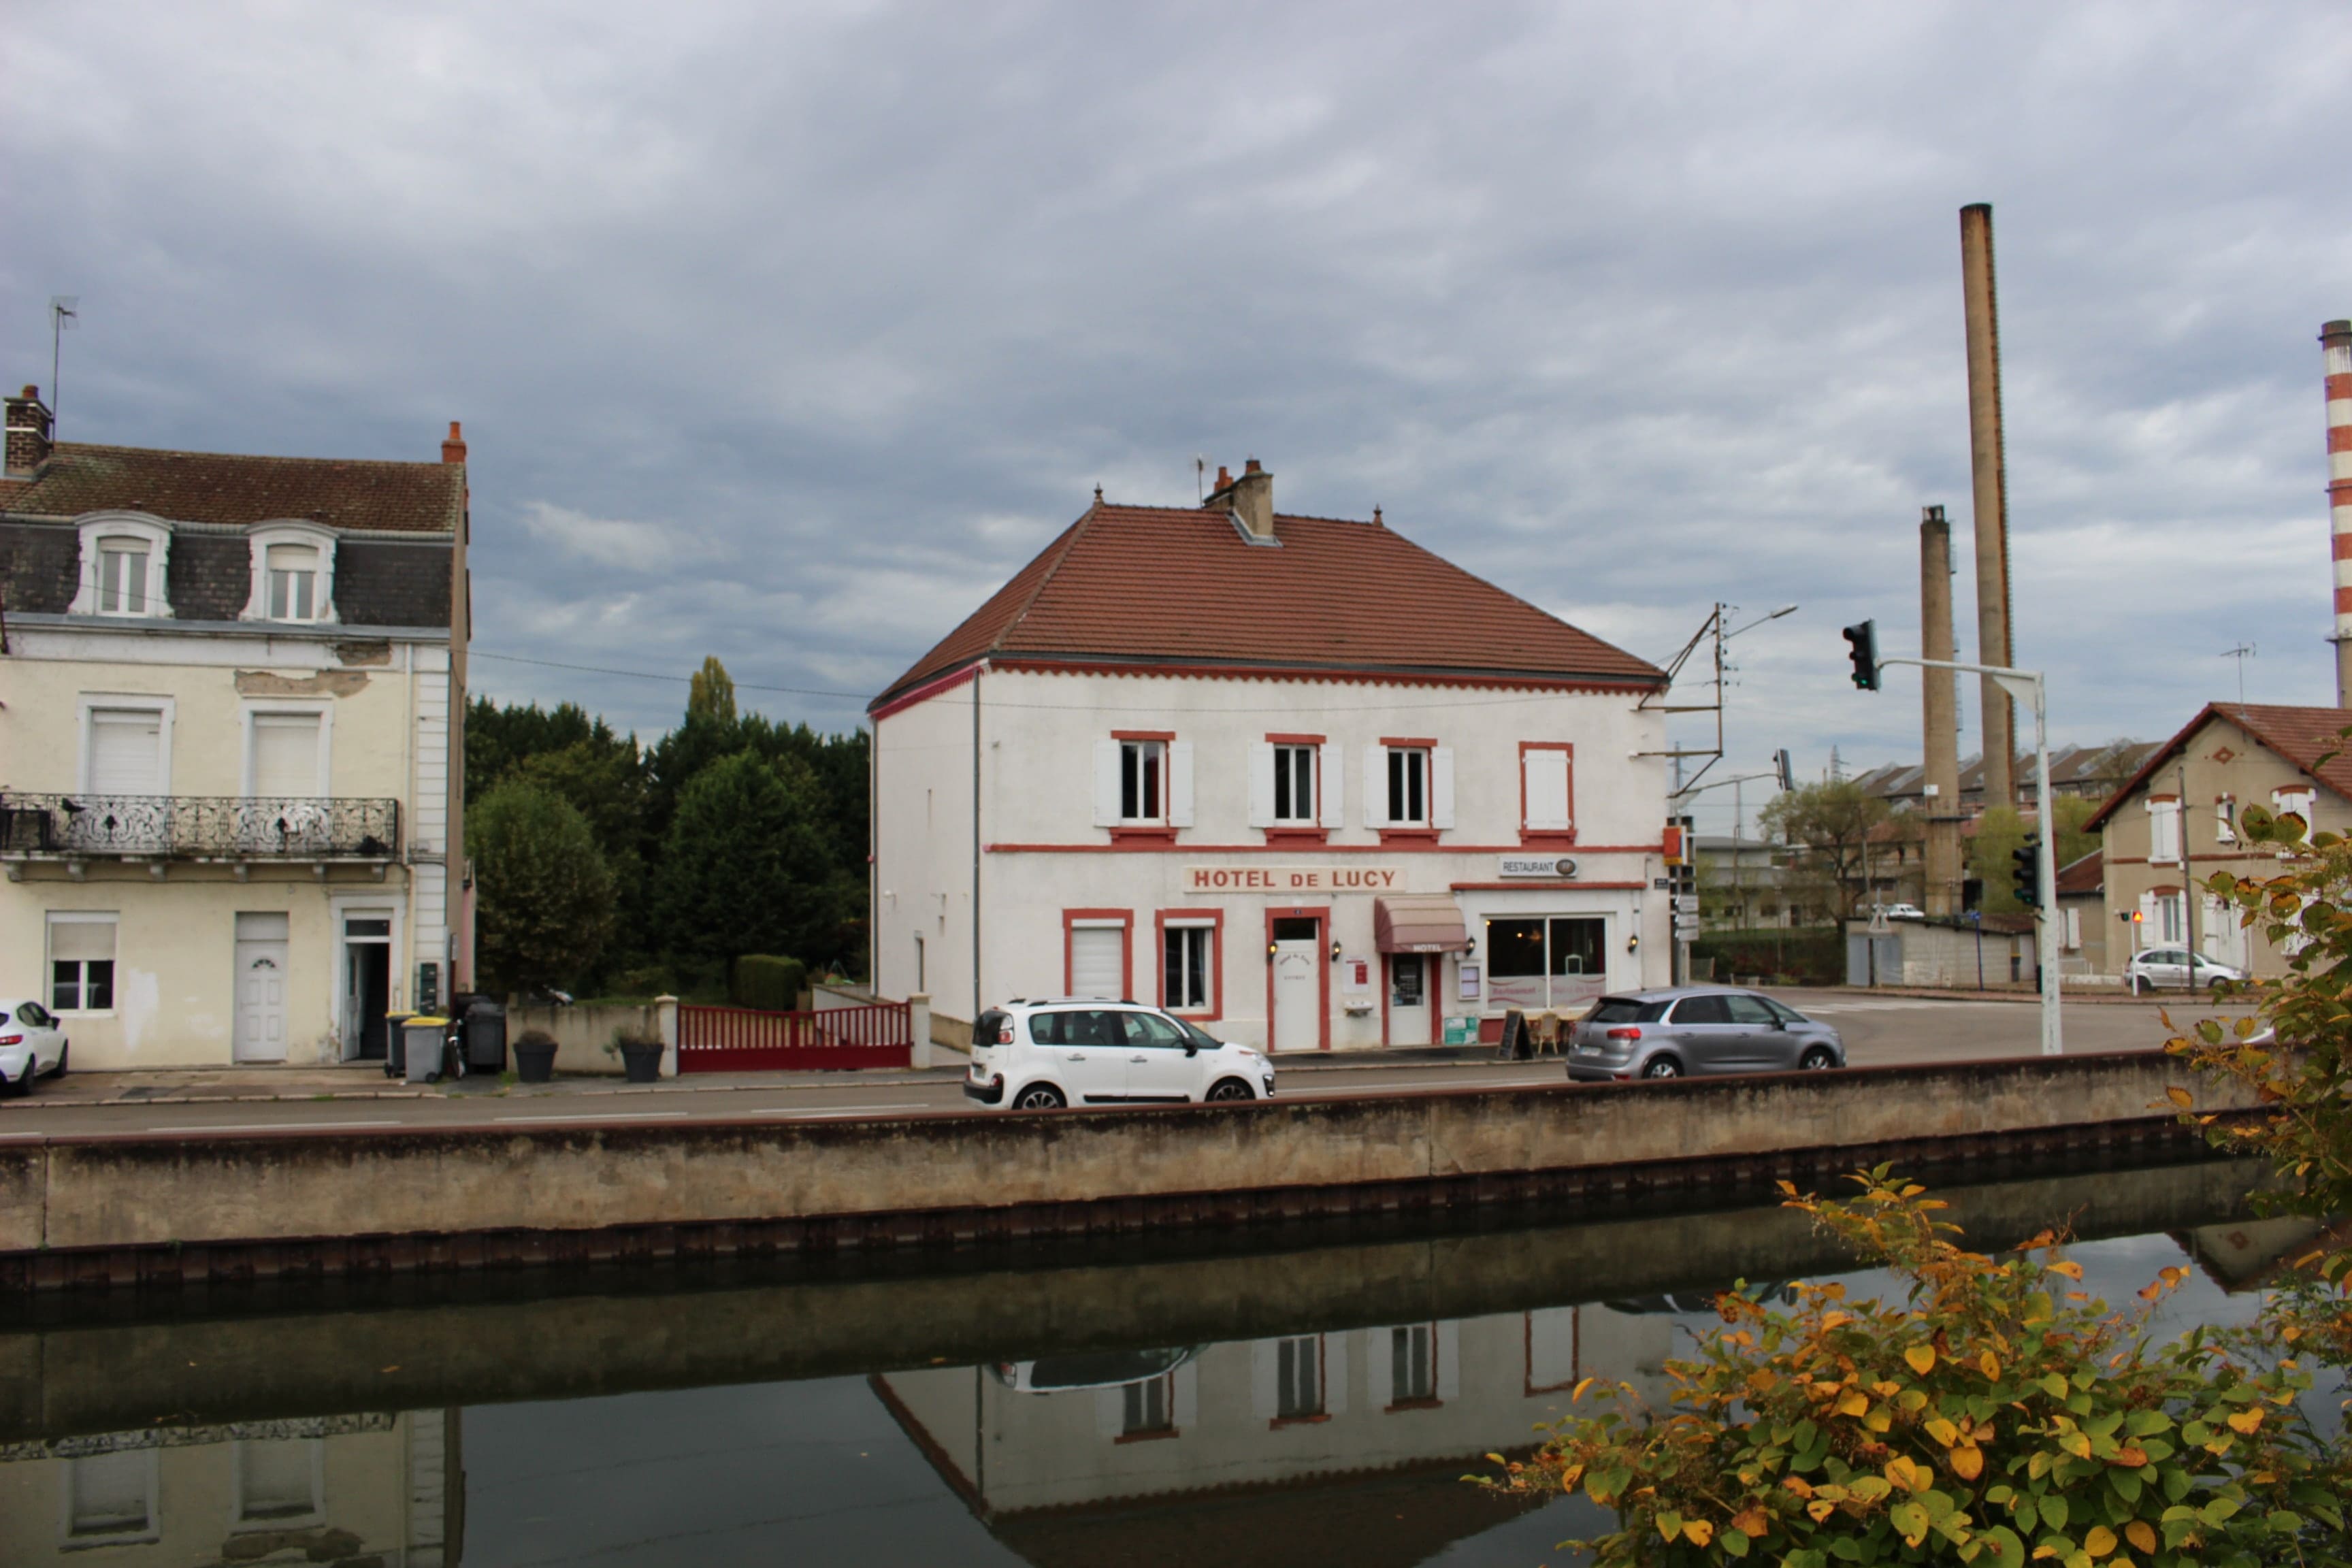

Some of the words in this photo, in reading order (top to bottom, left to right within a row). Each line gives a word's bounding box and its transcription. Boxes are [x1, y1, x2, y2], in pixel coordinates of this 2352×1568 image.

[1503, 861, 1554, 872] RESTAURANT
[1194, 870, 1276, 887] HOTEL
[1290, 873, 1318, 887] DE
[1332, 870, 1395, 887] LUCY
[1413, 943, 1441, 952] HOTEL
